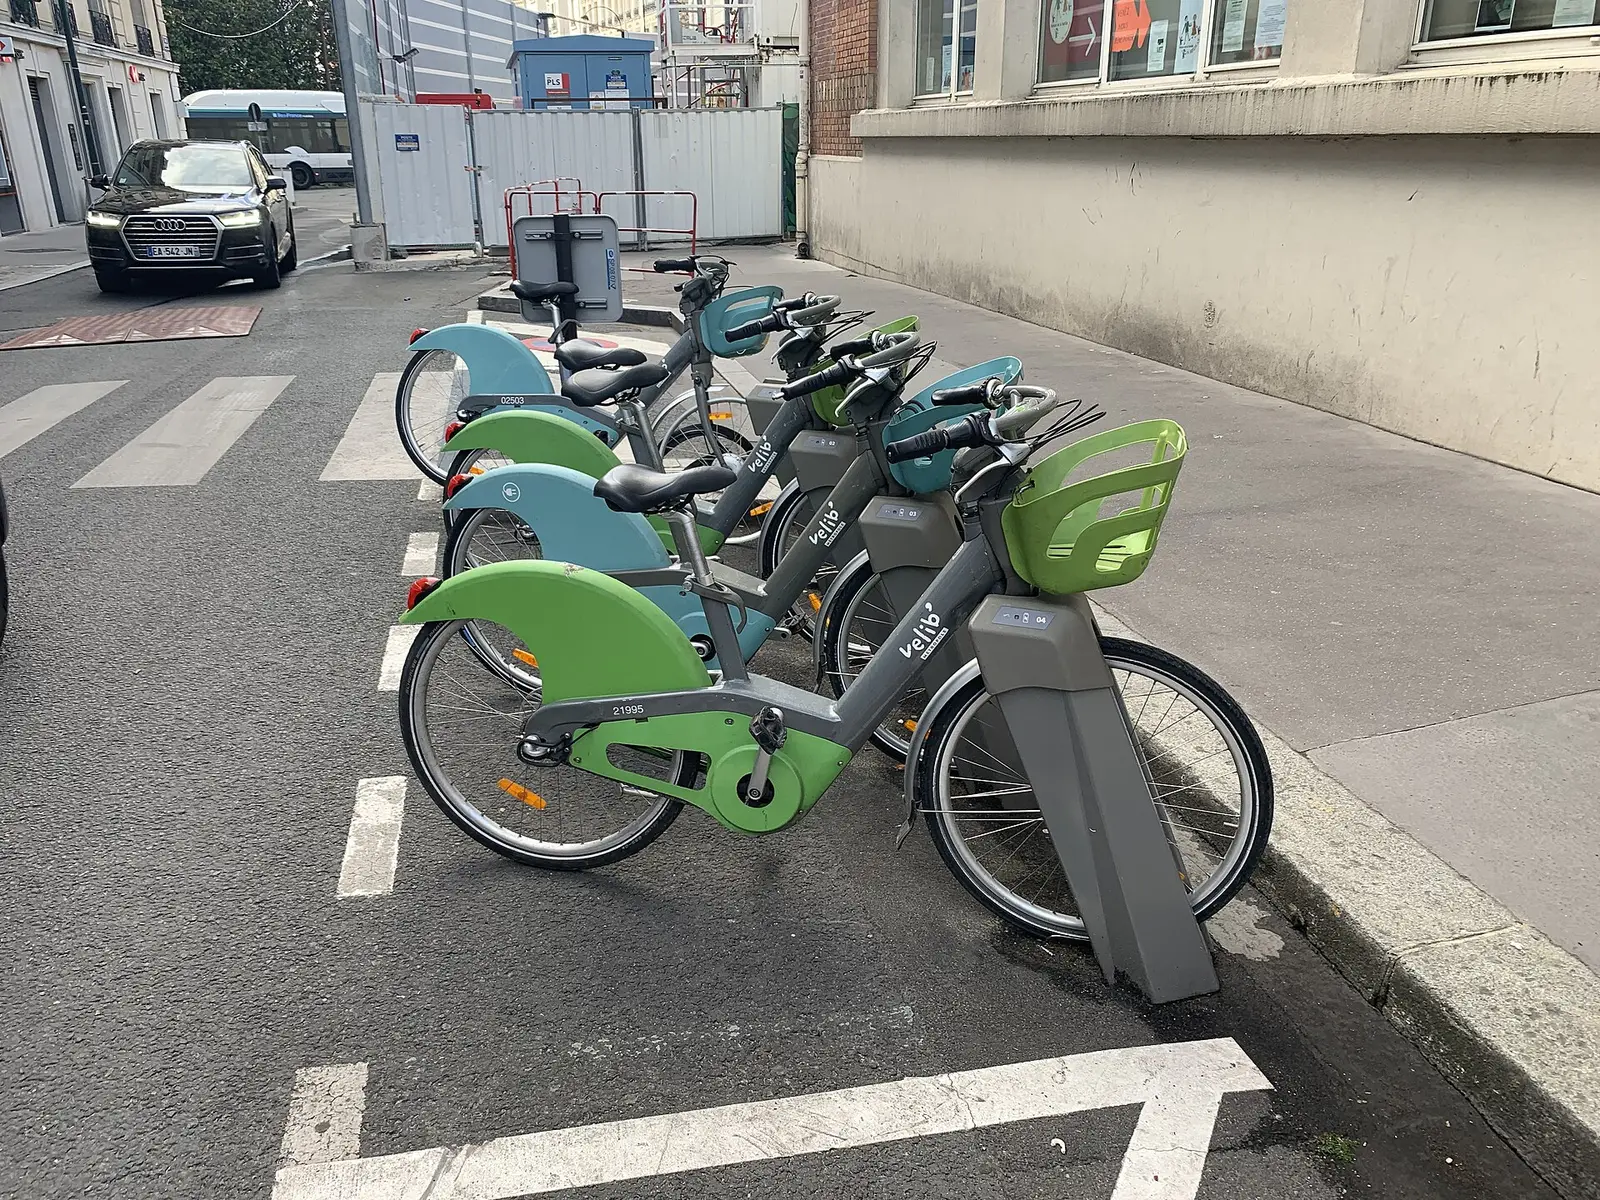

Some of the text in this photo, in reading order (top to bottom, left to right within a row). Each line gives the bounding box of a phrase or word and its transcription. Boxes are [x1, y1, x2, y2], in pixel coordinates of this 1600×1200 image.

[546, 78, 561, 86] PLS
[501, 396, 525, 405] 02503
[908, 510, 917, 518] 03
[1036, 616, 1047, 624] 04
[612, 704, 645, 716] 21995
